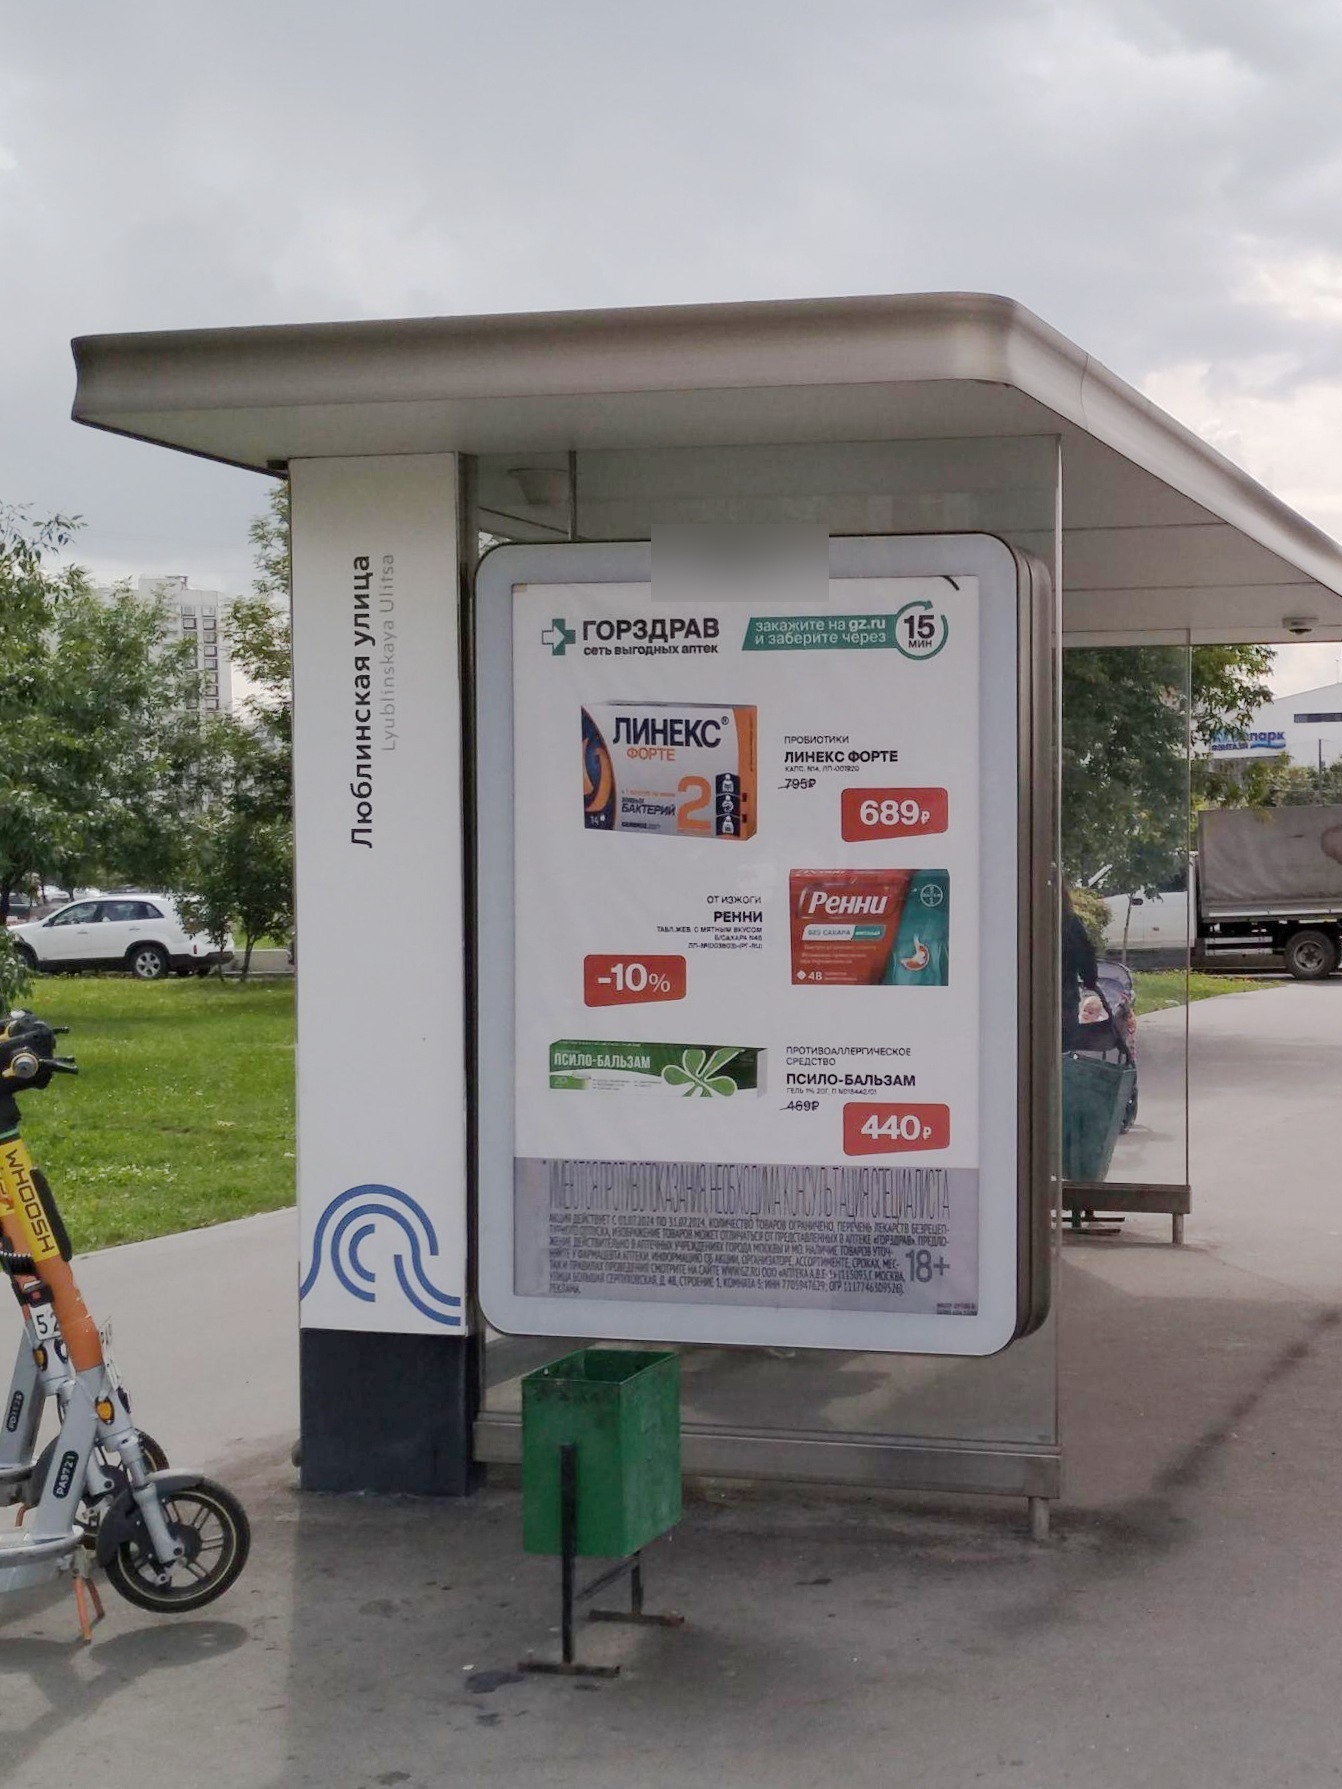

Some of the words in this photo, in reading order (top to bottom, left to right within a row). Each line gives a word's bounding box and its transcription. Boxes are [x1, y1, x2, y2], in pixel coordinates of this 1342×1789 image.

[378, 554, 395, 613] Ulitsa
[353, 555, 375, 648] улица
[582, 617, 720, 643] ГОРЗДРАВ
[755, 620, 825, 633] закажите
[828, 620, 846, 632] на
[849, 618, 886, 633] gz.ru
[903, 614, 936, 639] 15
[754, 634, 765, 645] и
[768, 632, 838, 647] заберите
[842, 631, 887, 645] через
[583, 645, 612, 656] сеть
[613, 644, 680, 657] выгодных
[680, 644, 719, 655] аптек
[379, 619, 399, 751] Lyublinskaya
[784, 735, 850, 745] ПРОБИОТИКИ
[350, 655, 373, 849] Люблинская
[626, 747, 676, 761] ФОРТЕ
[784, 751, 845, 763] ЛИНЕКС
[847, 749, 899, 763] ФОРТЕ
[621, 803, 677, 817] БАКТЕРИЙ
[676, 775, 712, 830] 2
[706, 895, 720, 904] ОТ
[721, 894, 762, 904] ИЗЖОГИ
[807, 890, 889, 915] Ренни
[713, 910, 763, 923] РЕННИ
[733, 926, 763, 934] ВКУСОМ
[597, 963, 671, 993] -10%
[786, 1045, 912, 1057] ПРОТИВОАЛЛЕРГИЧЕСКОЕ
[553, 1052, 651, 1069] ПСИЛО-БАЛЬЗАМ
[786, 1057, 836, 1066] СРЕДСТВО
[786, 1073, 916, 1087] ПСИЛО-БАЛЬЗАМ
[5, 1148, 56, 1253] WHOOSH
[904, 1249, 950, 1283] 18+
[56, 1454, 76, 1496] PA9721
